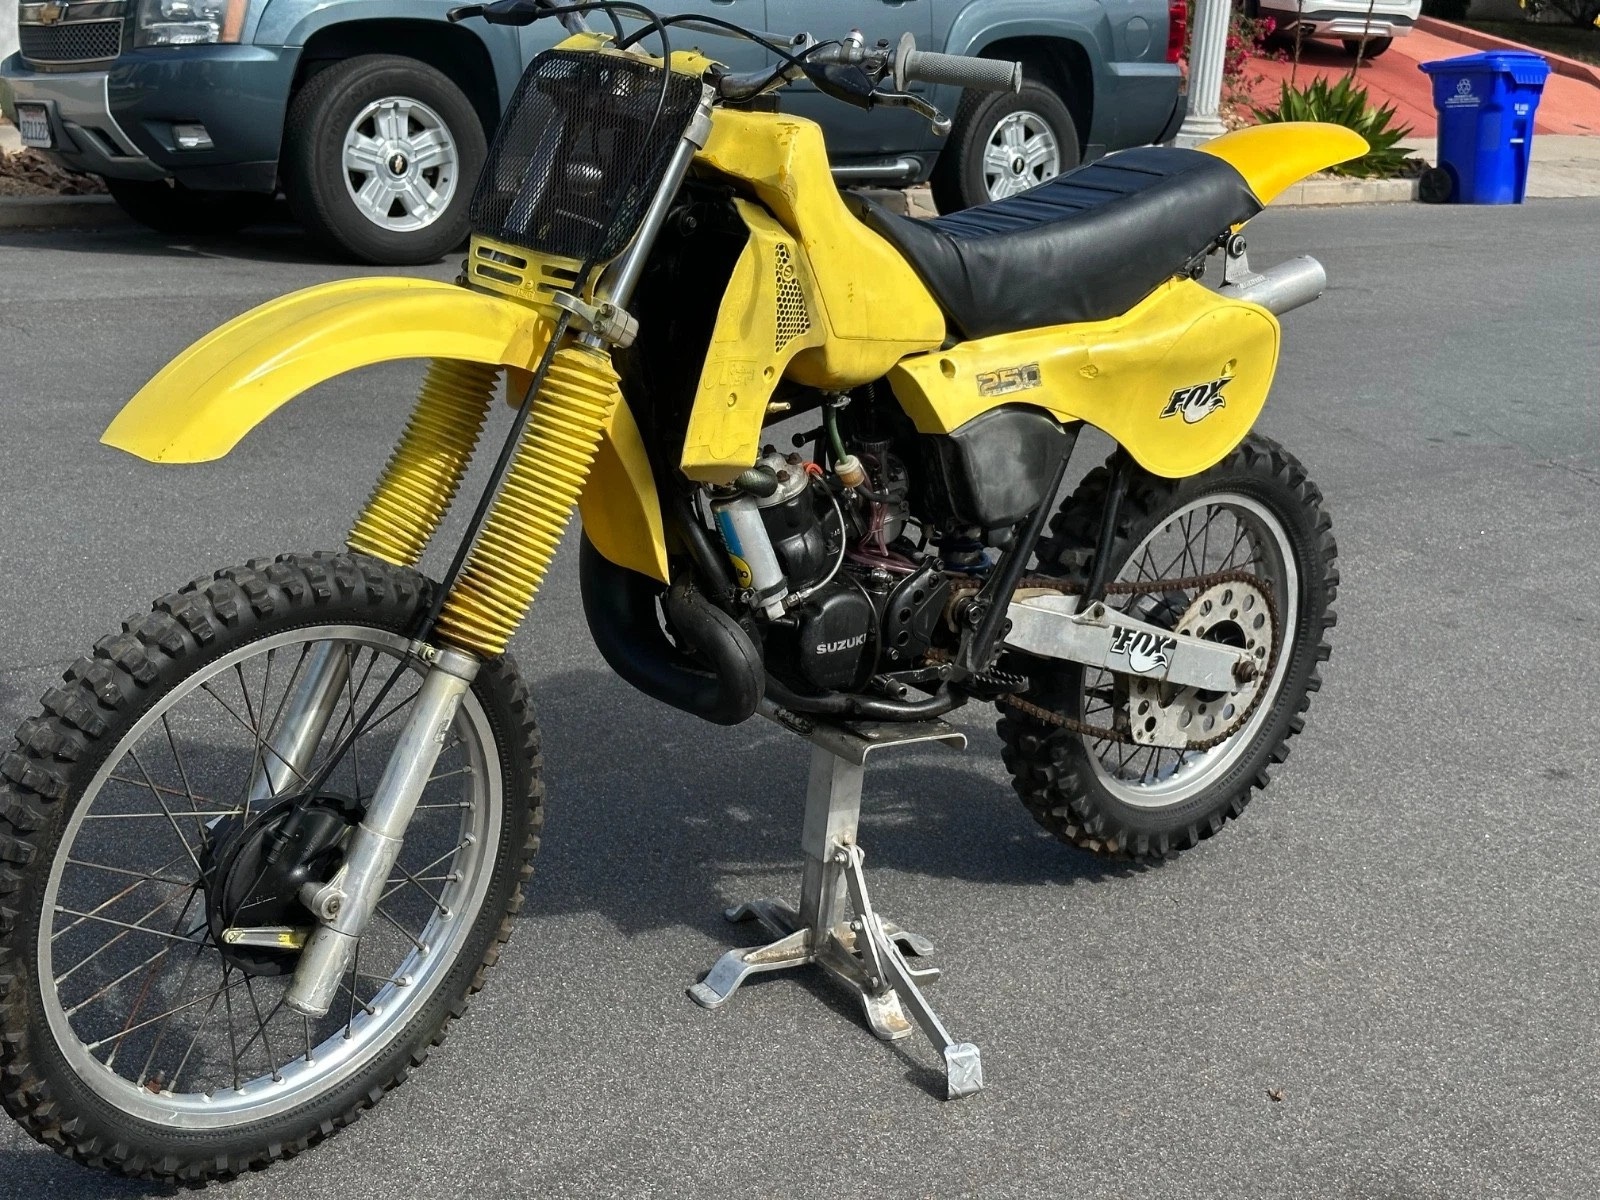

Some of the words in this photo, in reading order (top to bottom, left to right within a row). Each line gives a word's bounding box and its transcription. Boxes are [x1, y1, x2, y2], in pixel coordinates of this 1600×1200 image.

[976, 362, 1042, 396] 250
[1160, 376, 1234, 418] FOX
[816, 632, 867, 655] SUZUKI
[1110, 626, 1173, 657] FOX
